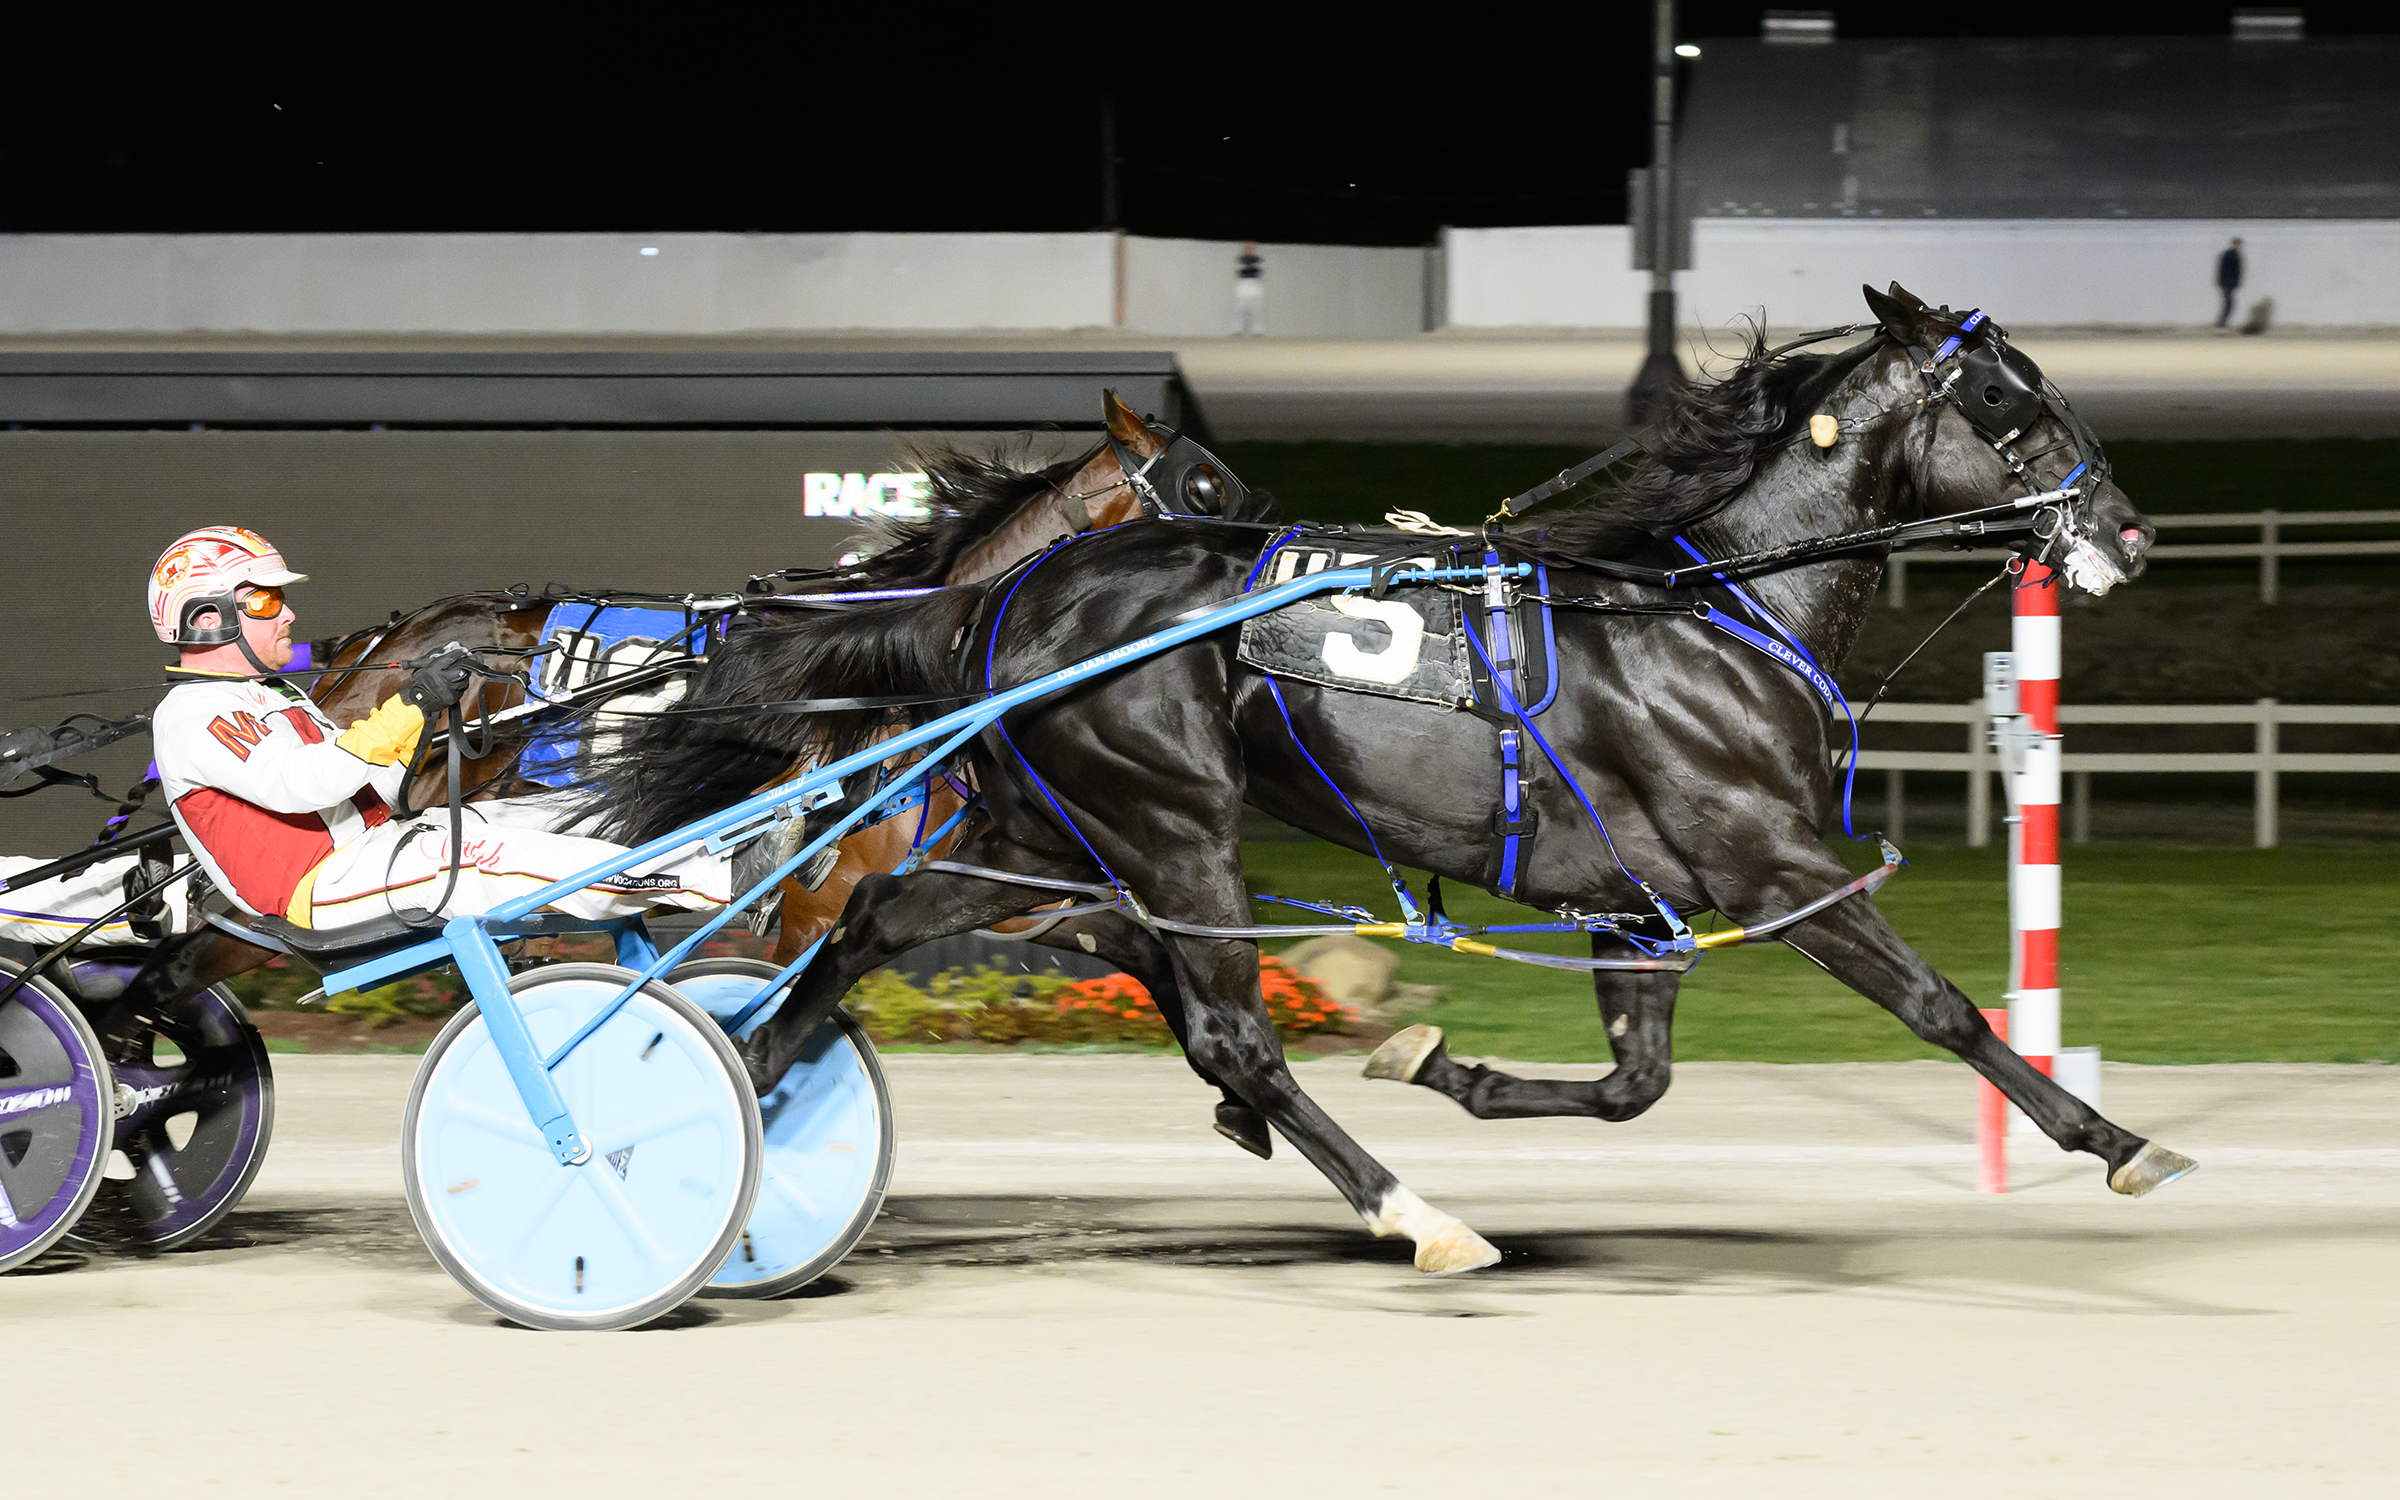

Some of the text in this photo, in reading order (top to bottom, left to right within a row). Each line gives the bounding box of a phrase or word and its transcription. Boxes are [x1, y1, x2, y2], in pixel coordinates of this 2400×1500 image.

[803, 472, 932, 517] RACE
[1322, 553, 1438, 685] 5
[1056, 636, 1159, 681] DR. IAN MOORE
[1768, 642, 1812, 678] CLEVER
